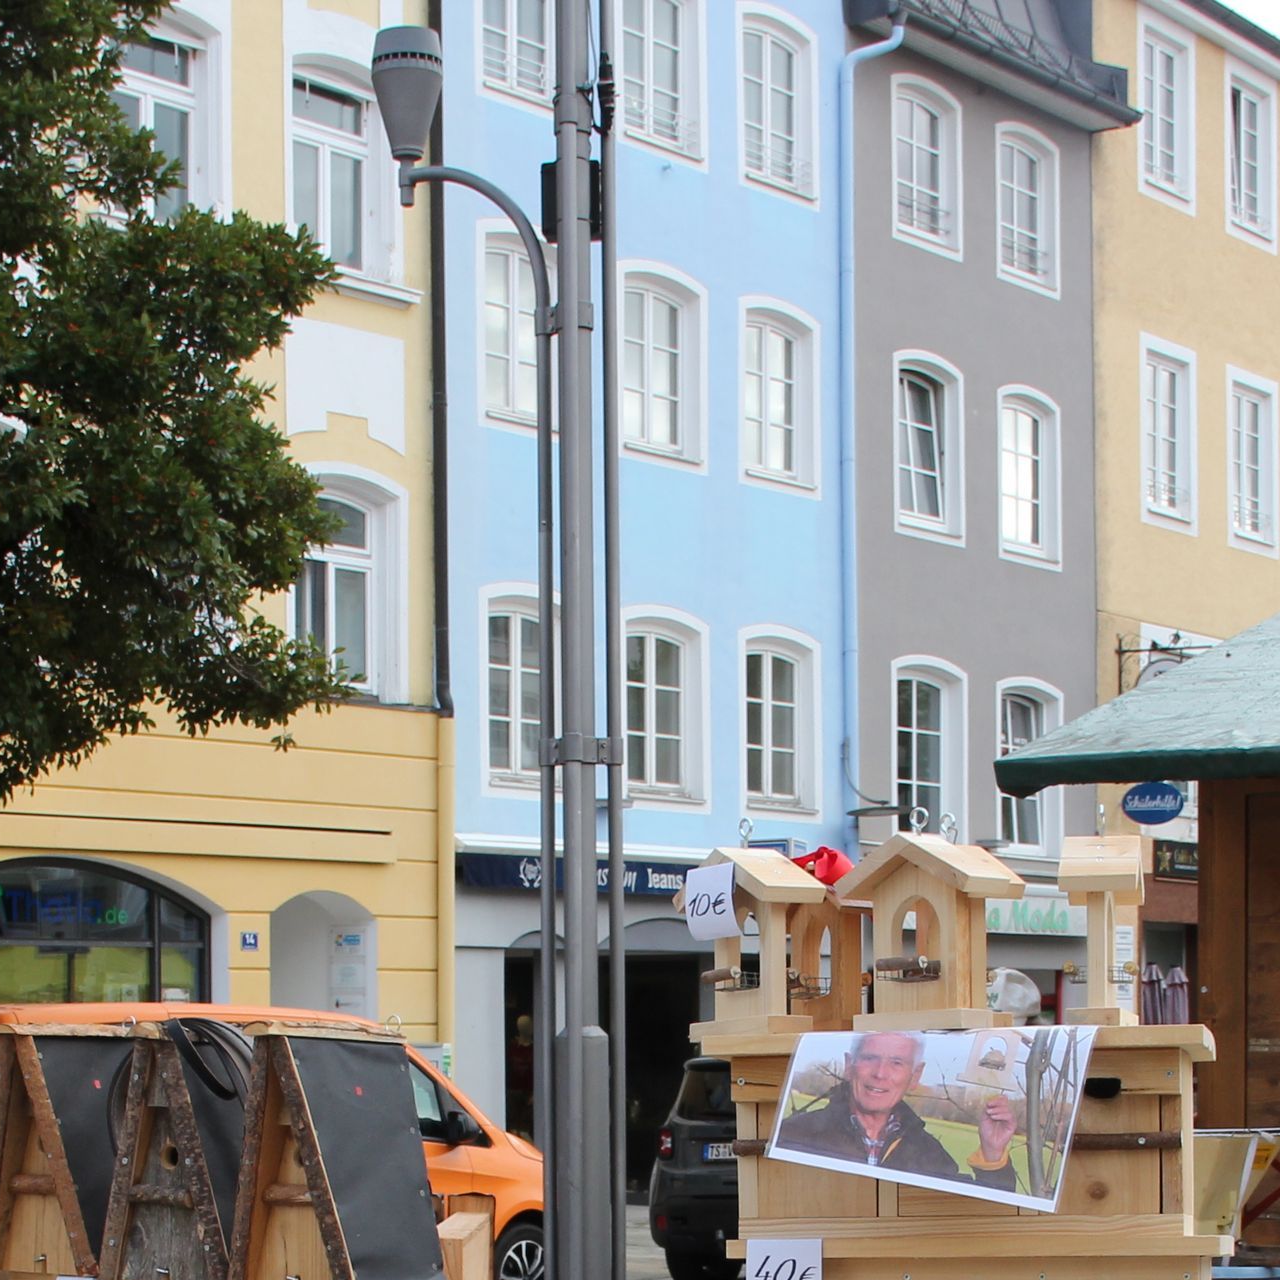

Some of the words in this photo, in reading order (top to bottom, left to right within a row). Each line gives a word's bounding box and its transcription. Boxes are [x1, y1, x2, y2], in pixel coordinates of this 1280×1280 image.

[688, 892, 726, 917] 10€
[1009, 900, 1070, 933] Moda
[245, 933, 256, 944] 14
